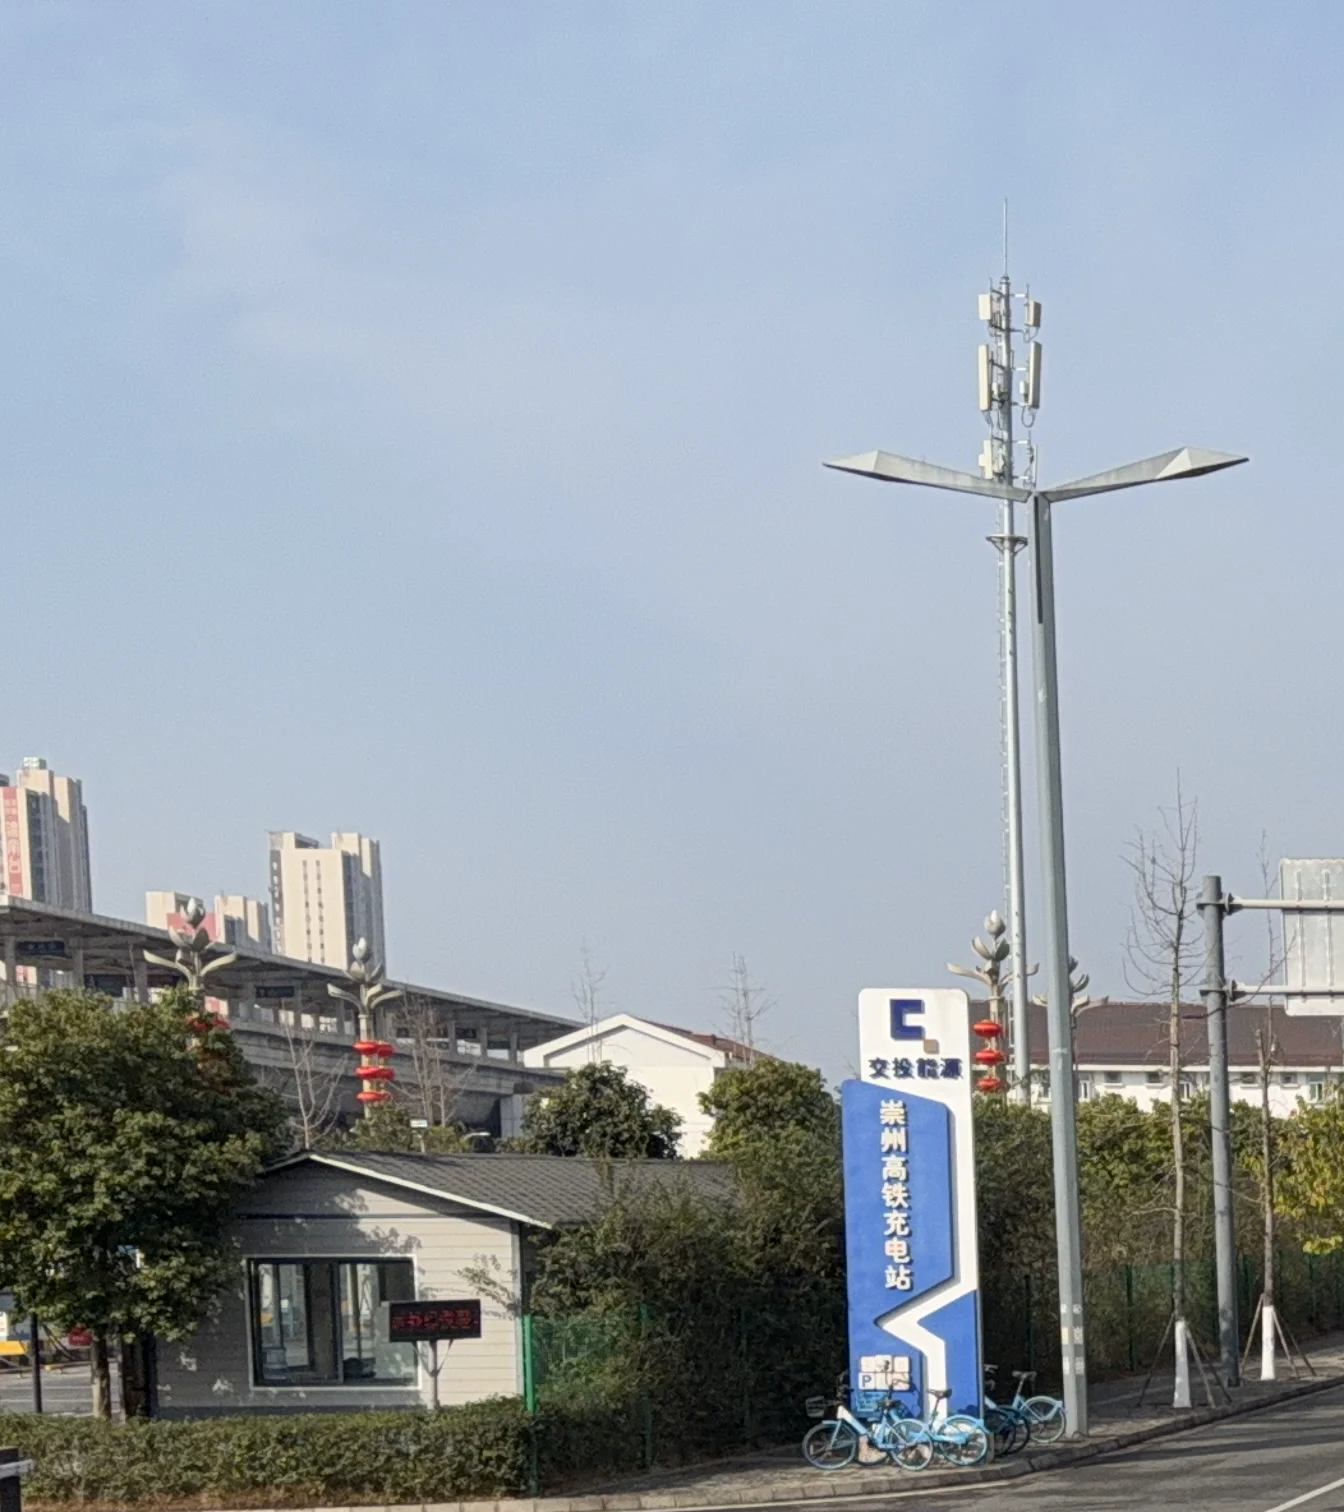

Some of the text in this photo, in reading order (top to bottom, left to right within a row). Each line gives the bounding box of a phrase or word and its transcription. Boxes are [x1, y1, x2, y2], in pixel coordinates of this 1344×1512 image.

[868, 1057, 963, 1080] 交投能源
[879, 1099, 912, 1291] 崇州高铁充电站
